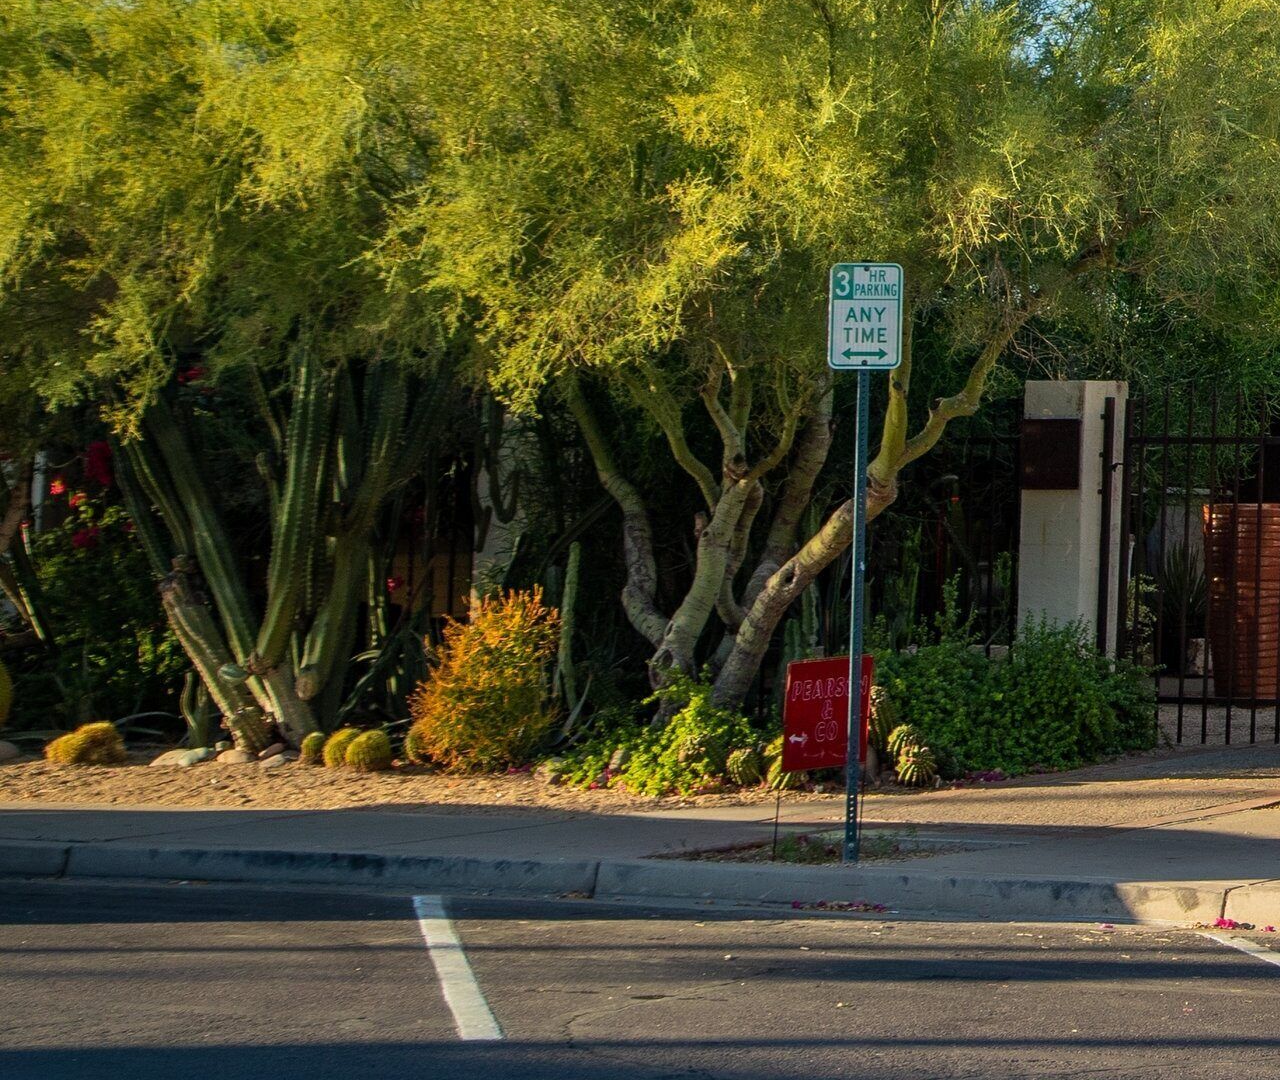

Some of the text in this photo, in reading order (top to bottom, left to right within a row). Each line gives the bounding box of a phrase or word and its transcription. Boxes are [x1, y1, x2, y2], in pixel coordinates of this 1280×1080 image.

[836, 271, 850, 297] 3
[869, 270, 886, 282] HR
[855, 283, 897, 297] PARKING
[845, 307, 887, 323] ANY
[843, 327, 888, 343] TIME
[814, 720, 839, 742] CO
